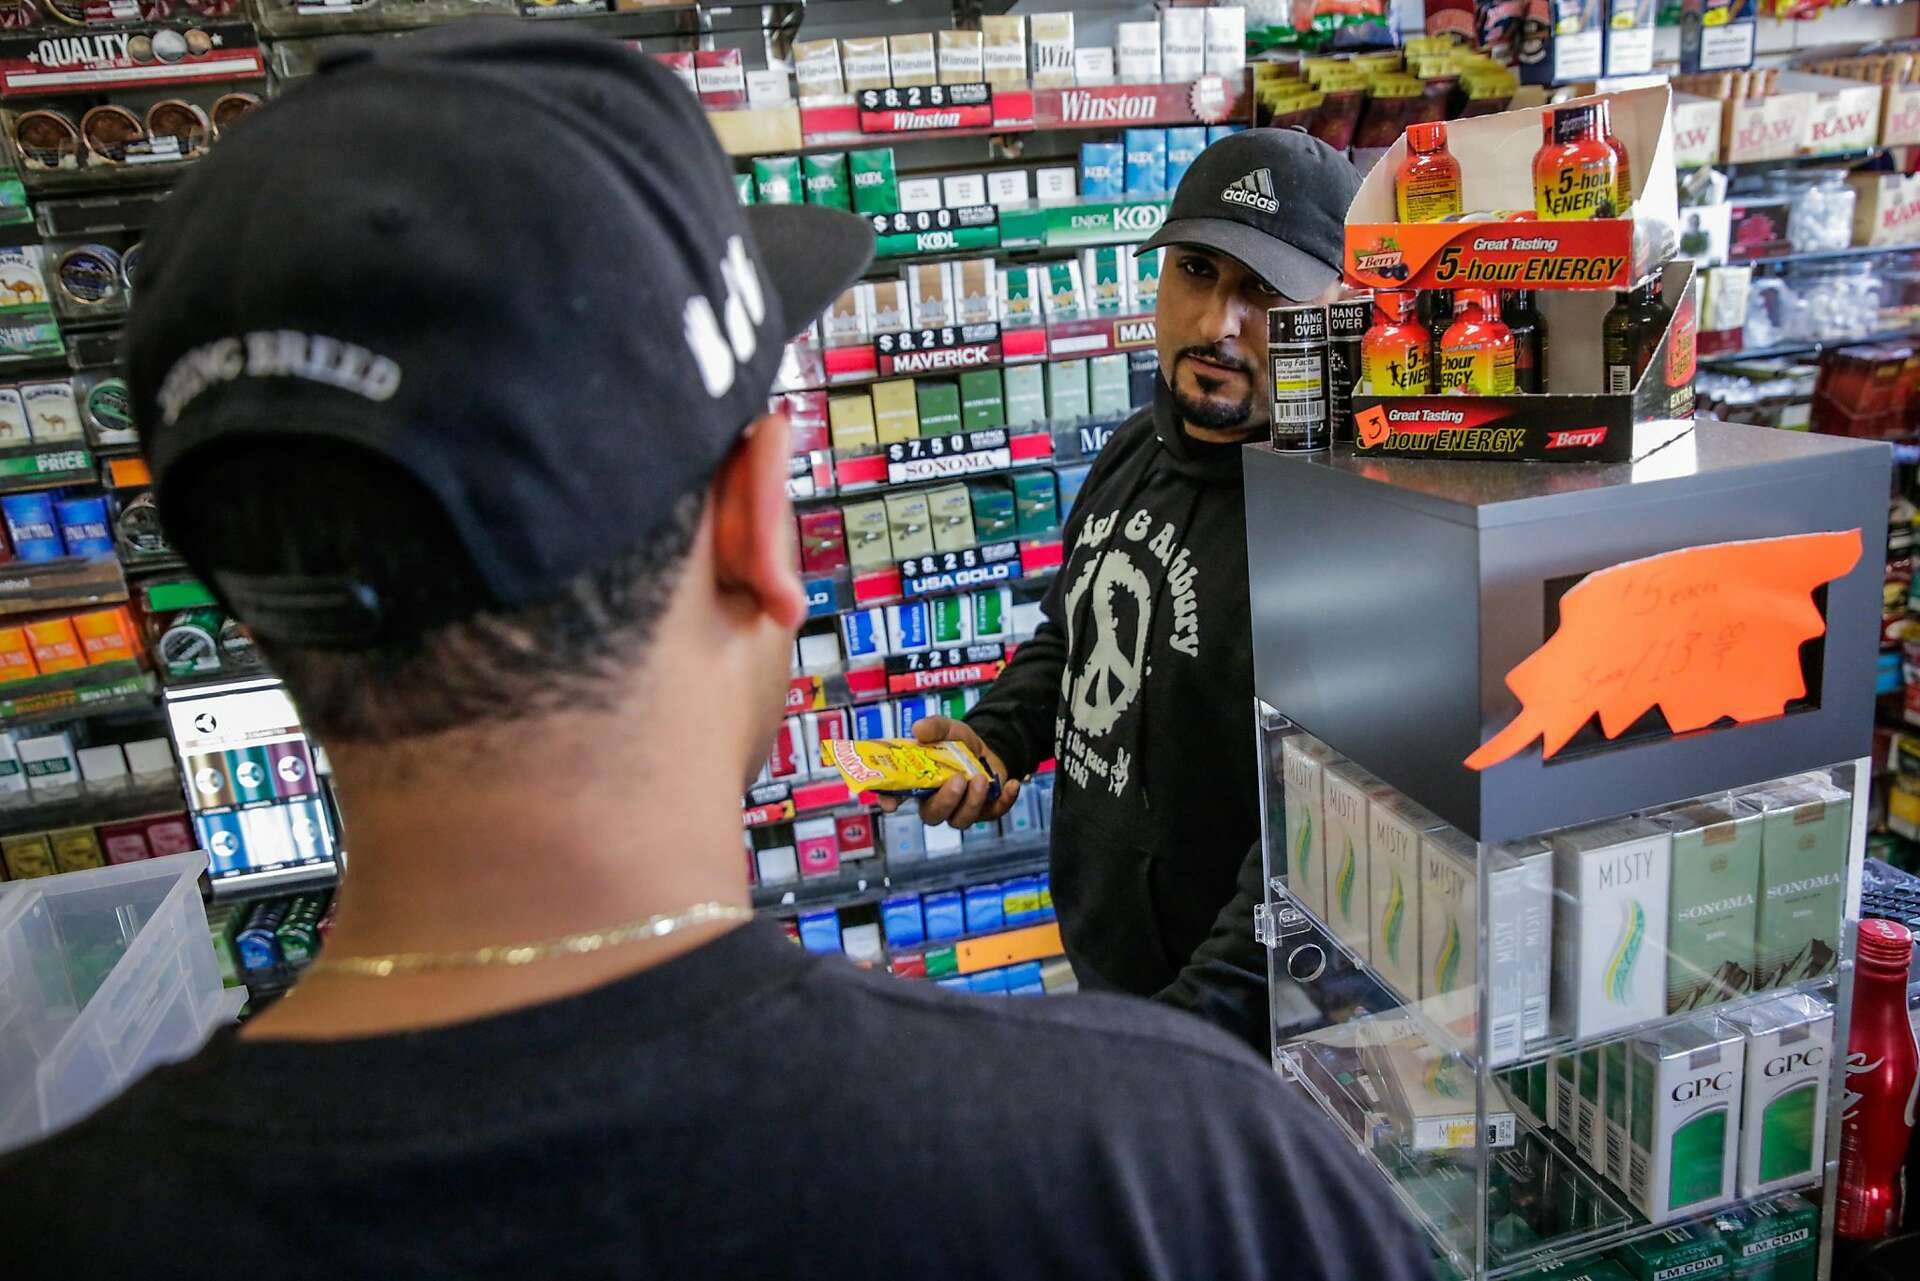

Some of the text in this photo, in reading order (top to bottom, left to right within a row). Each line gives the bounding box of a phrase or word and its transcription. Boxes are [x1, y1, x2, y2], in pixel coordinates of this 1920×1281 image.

[38, 32, 131, 68] QUALITY
[1060, 89, 1157, 123] Winston
[893, 110, 960, 131] Winston
[1738, 117, 1795, 149] RAW
[1811, 111, 1869, 141] RAW
[854, 171, 885, 187] KOOL
[1222, 189, 1278, 212] adidas
[916, 230, 960, 251] KOOL
[1473, 237, 1558, 253] Great Tasting
[0, 254, 34, 270] AMEL
[1363, 252, 1399, 269] Berry
[1435, 246, 1625, 282] 5-hour ENERGY
[1294, 312, 1323, 326] HANG
[1331, 306, 1364, 319] HANG
[1332, 318, 1364, 330] OVER
[1294, 324, 1323, 337] OVER
[893, 345, 990, 374] MAVERICK
[1368, 416, 1382, 440] 3
[1388, 409, 1465, 424] Great Tasting
[1435, 427, 1525, 452] ENERGY
[1555, 431, 1602, 447] Berry
[37, 456, 86, 472] PRICE
[905, 454, 993, 479] SONOMA
[912, 563, 1009, 593] USA GOLD
[914, 664, 982, 687] Fortuna
[1288, 755, 1314, 794] MISTY
[1328, 788, 1361, 826] MISTY
[1375, 821, 1409, 862] MISTY
[1429, 859, 1465, 896] MISTY
[1599, 848, 1654, 890] MISTY
[1766, 872, 1841, 899] SONOMA
[1678, 893, 1755, 921] SONOMA
[1764, 1046, 1824, 1078] GPC
[1671, 1071, 1733, 1102] GPC
[1746, 1230, 1805, 1255] LM.COM
[1657, 1256, 1720, 1281] LM.COM
